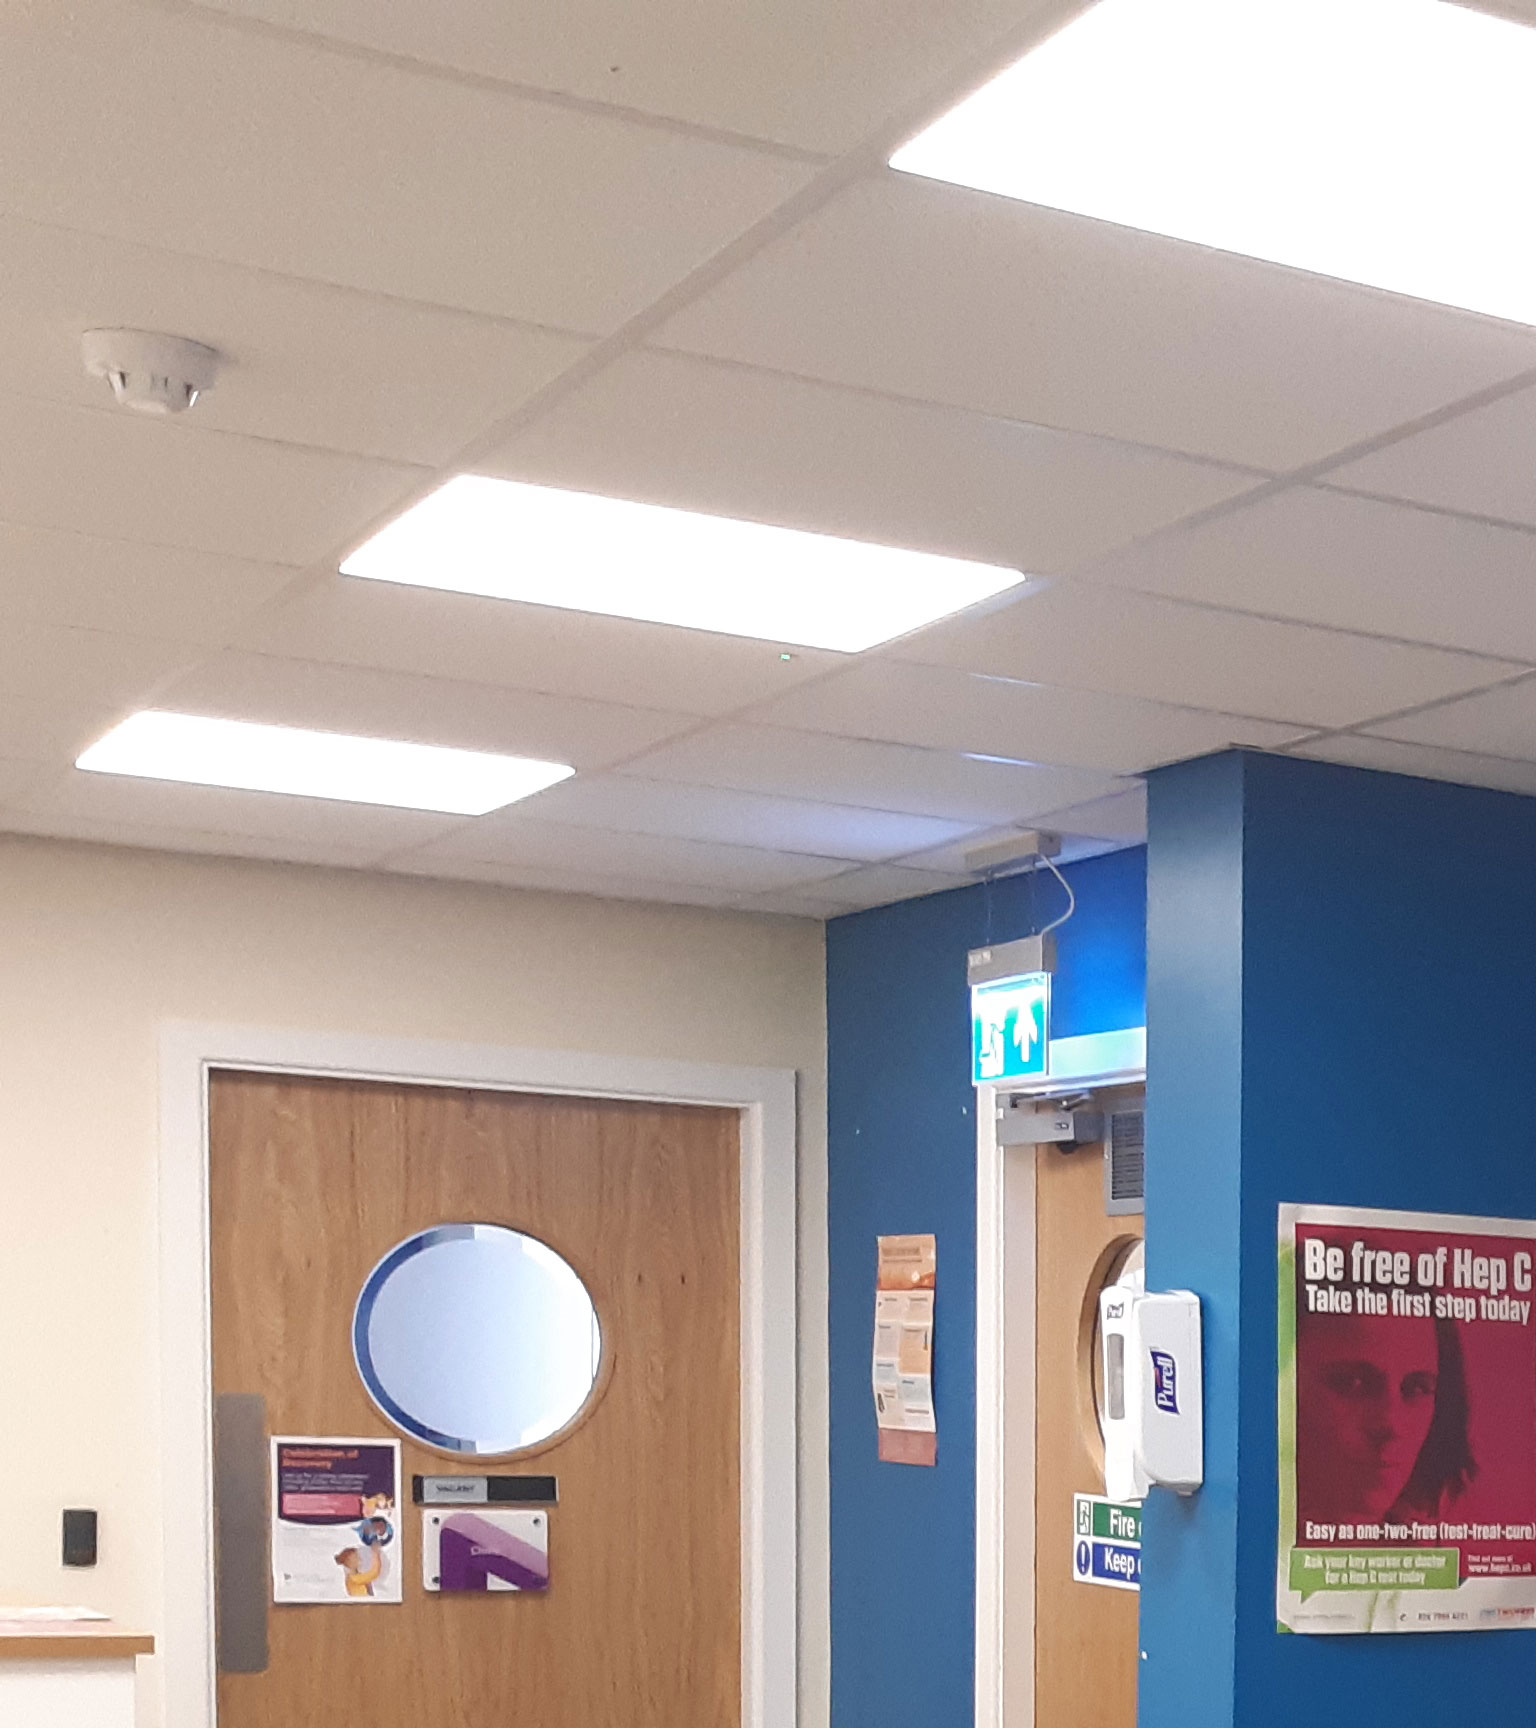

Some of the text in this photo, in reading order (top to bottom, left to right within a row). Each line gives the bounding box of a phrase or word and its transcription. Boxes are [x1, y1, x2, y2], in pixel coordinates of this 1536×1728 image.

[1304, 1238, 1532, 1296] Be free of Hep C
[1305, 1284, 1531, 1326] Take the first step today
[1156, 1355, 1174, 1407] Purell
[1109, 1508, 1136, 1538] Fire
[1305, 1521, 1536, 1542] Easy as one-two-free (test-treat-cure)
[1104, 1546, 1136, 1581] Keep
[1304, 1554, 1323, 1569] Ask
[1325, 1556, 1348, 1570] your
